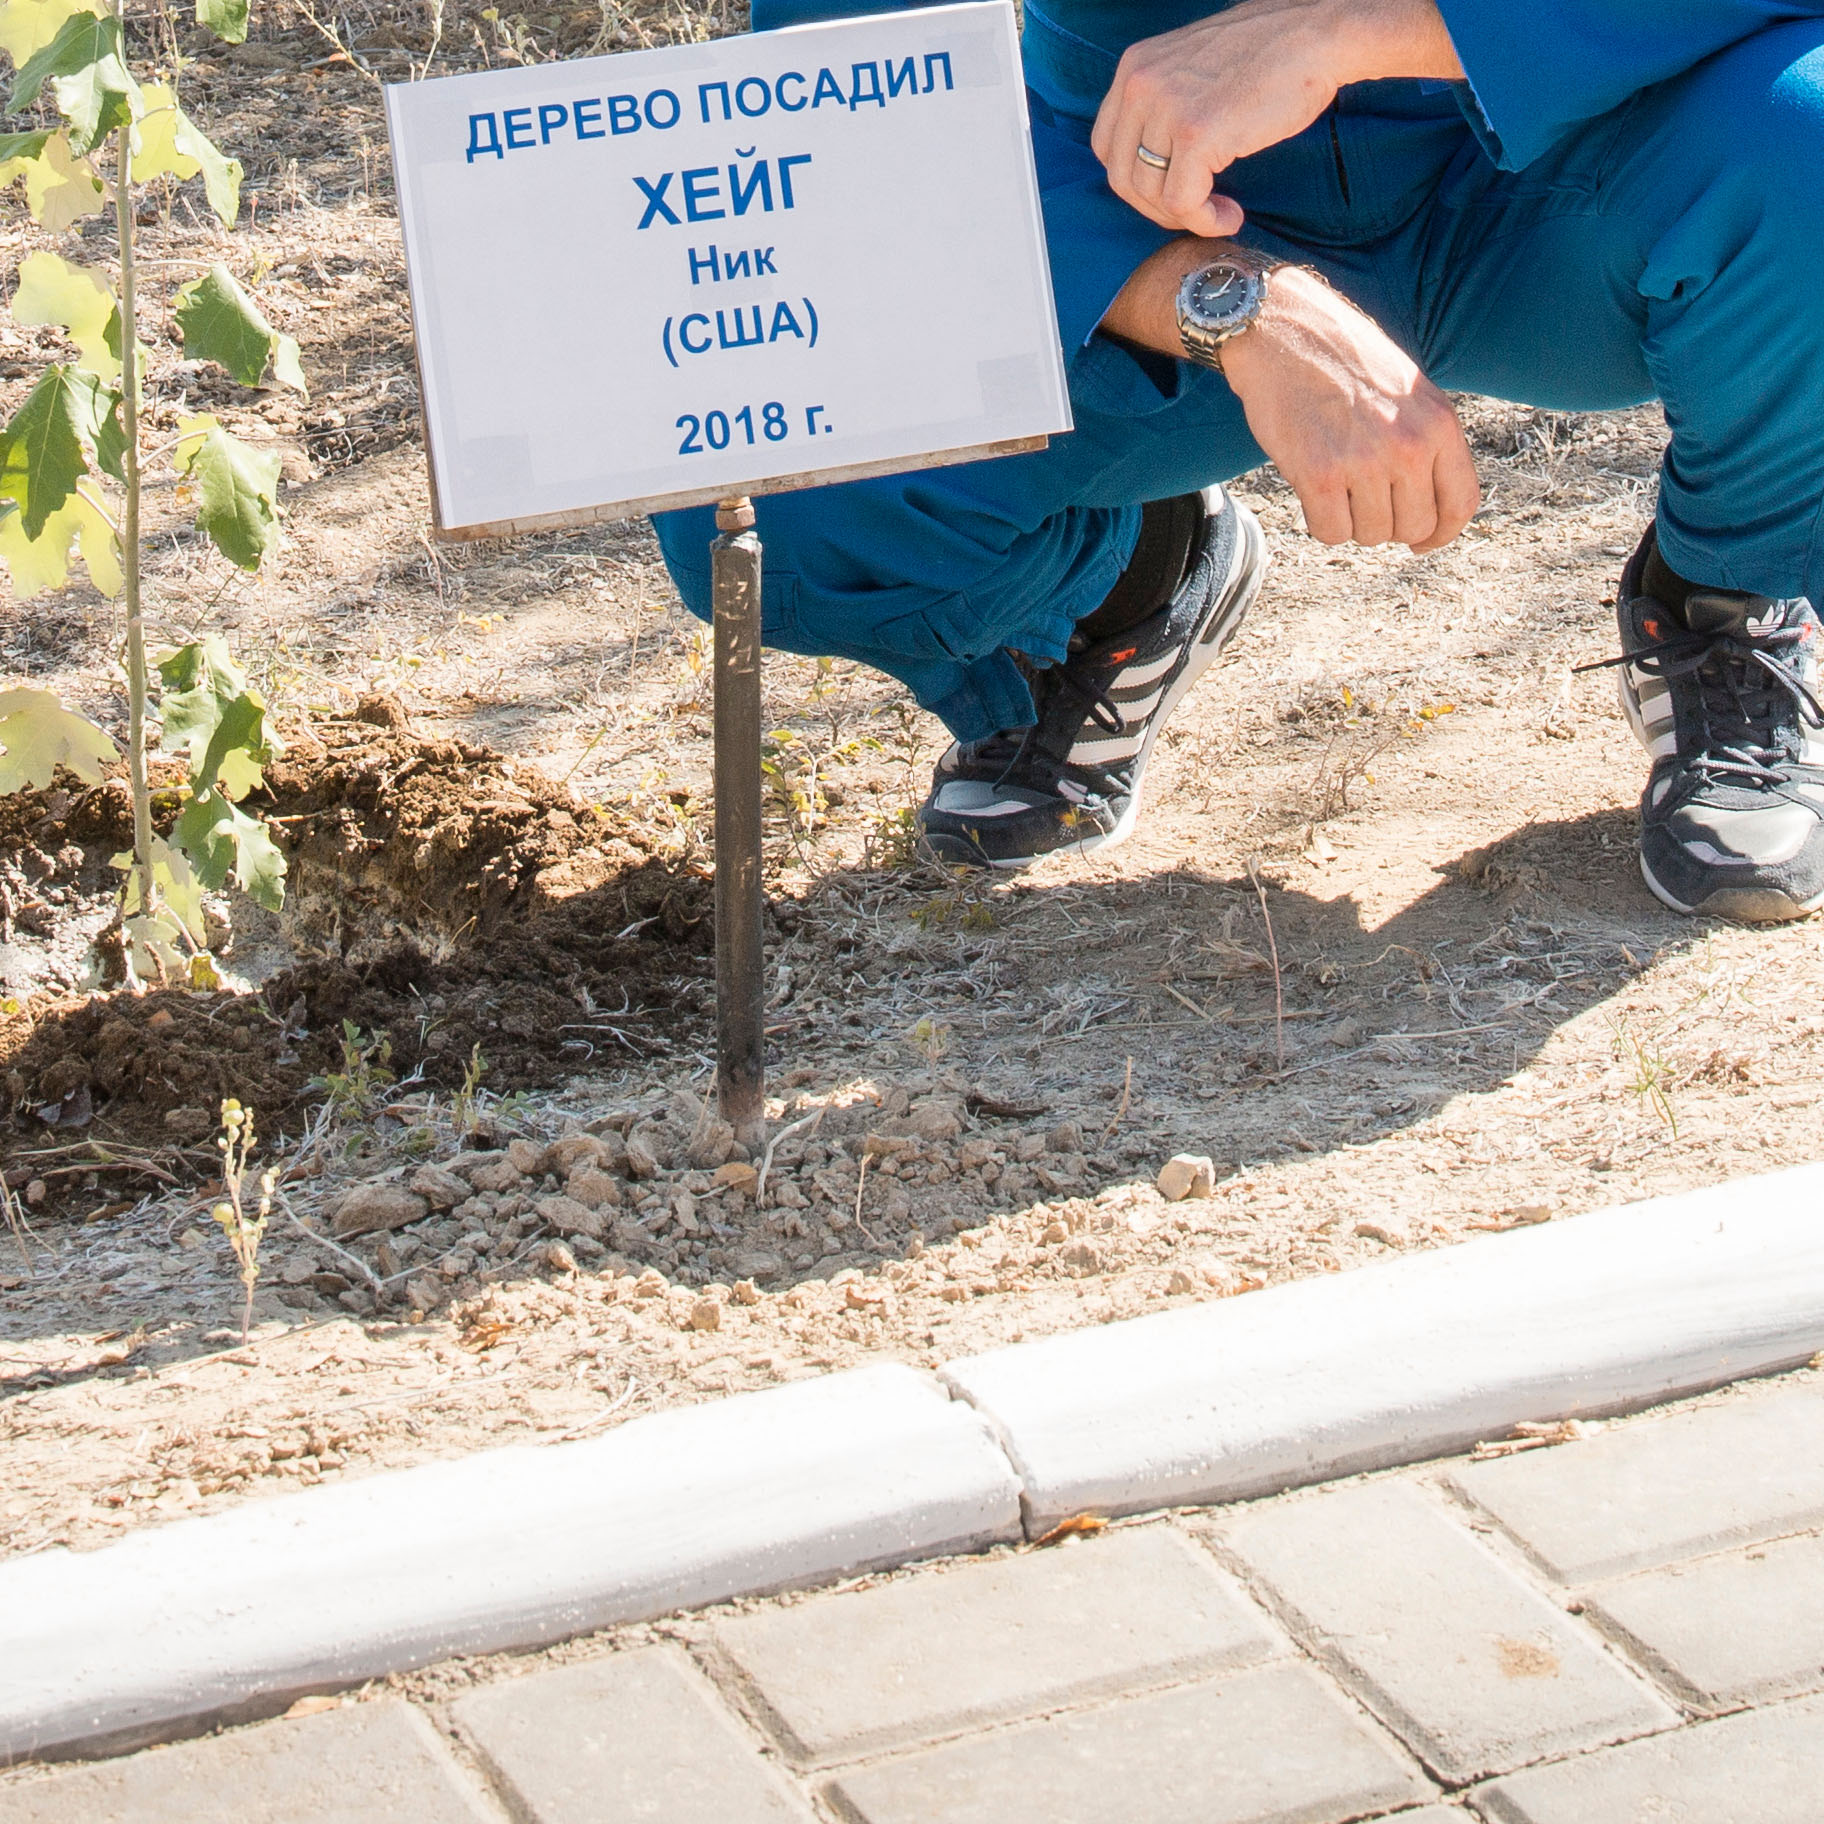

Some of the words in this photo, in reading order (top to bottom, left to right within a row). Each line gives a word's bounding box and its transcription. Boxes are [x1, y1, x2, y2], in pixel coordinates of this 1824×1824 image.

[465, 89, 681, 164] ДЕРЕВО
[698, 51, 954, 124] ПОСАДИЛ
[632, 146, 812, 231] ХЕЙГ
[687, 245, 778, 286] Ник
[662, 297, 820, 369] (США)
[675, 401, 789, 456] 2018
[805, 406, 834, 436] г.
